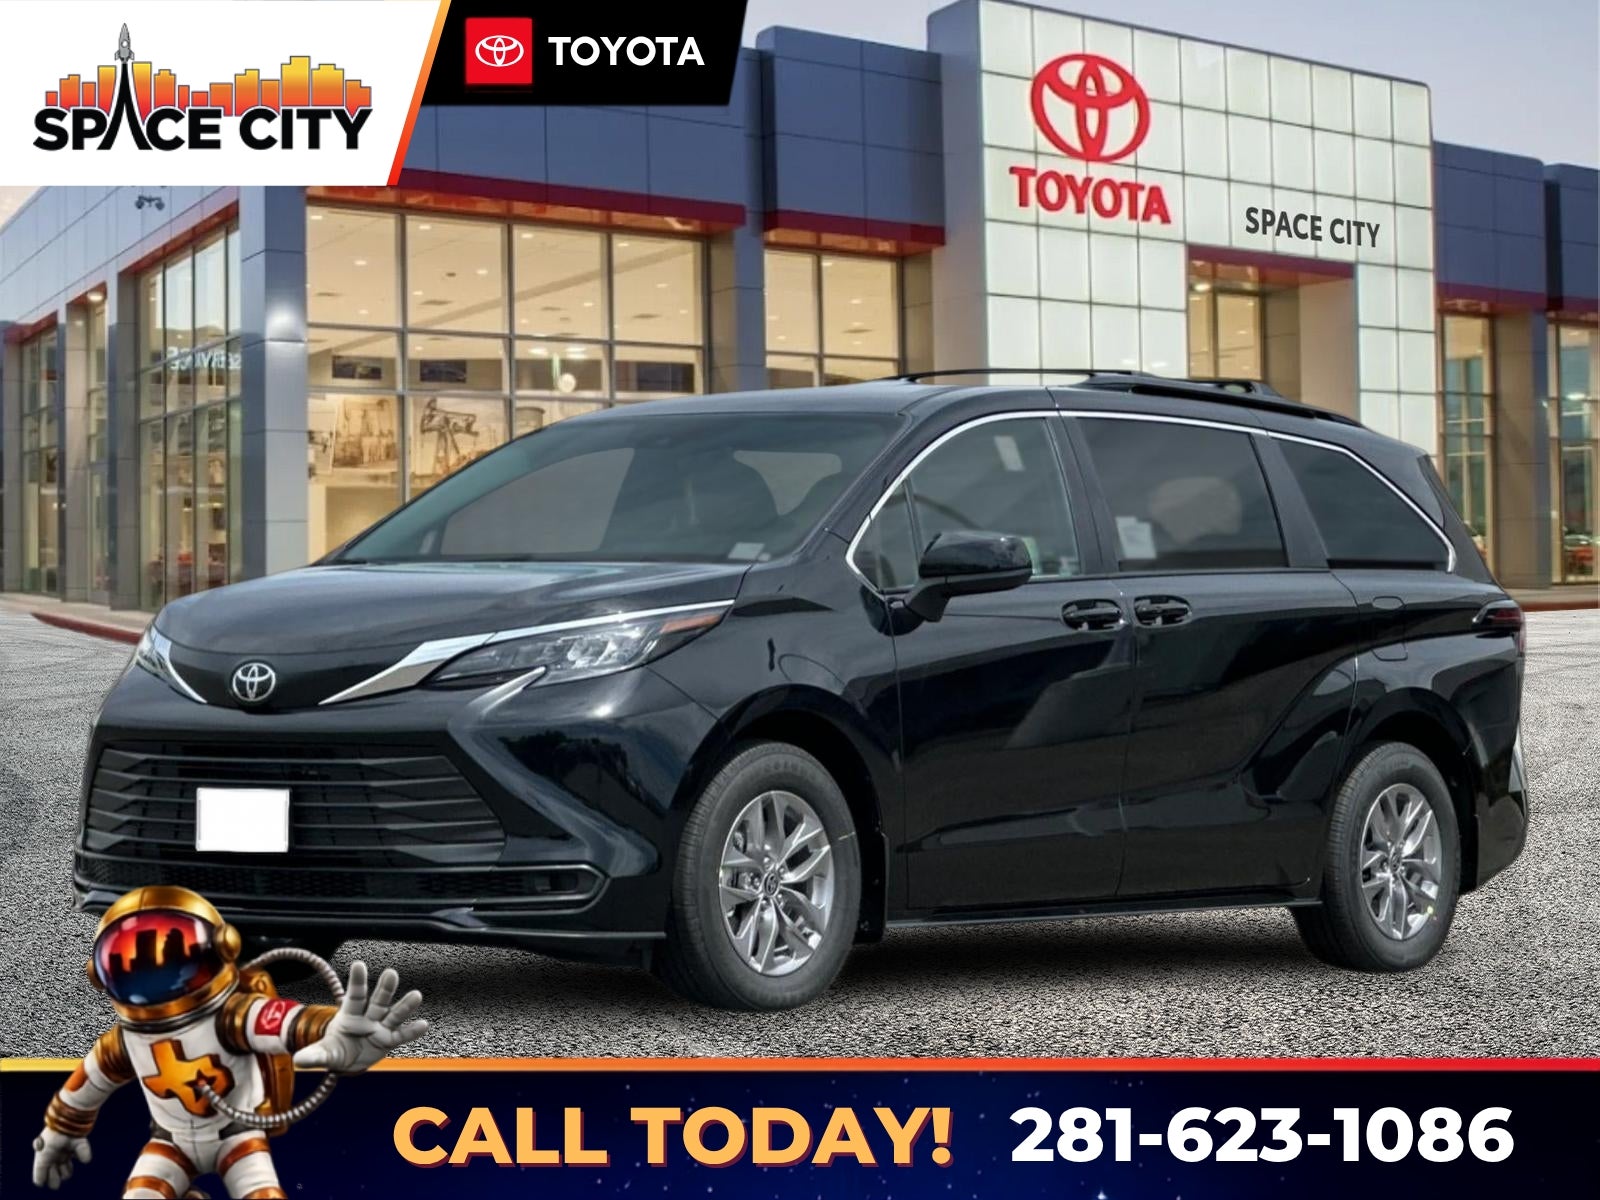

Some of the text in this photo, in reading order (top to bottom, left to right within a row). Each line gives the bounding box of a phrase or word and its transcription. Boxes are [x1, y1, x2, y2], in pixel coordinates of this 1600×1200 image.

[1009, 166, 1171, 224] TOYOTA
[1245, 206, 1381, 248] SPACE CITY
